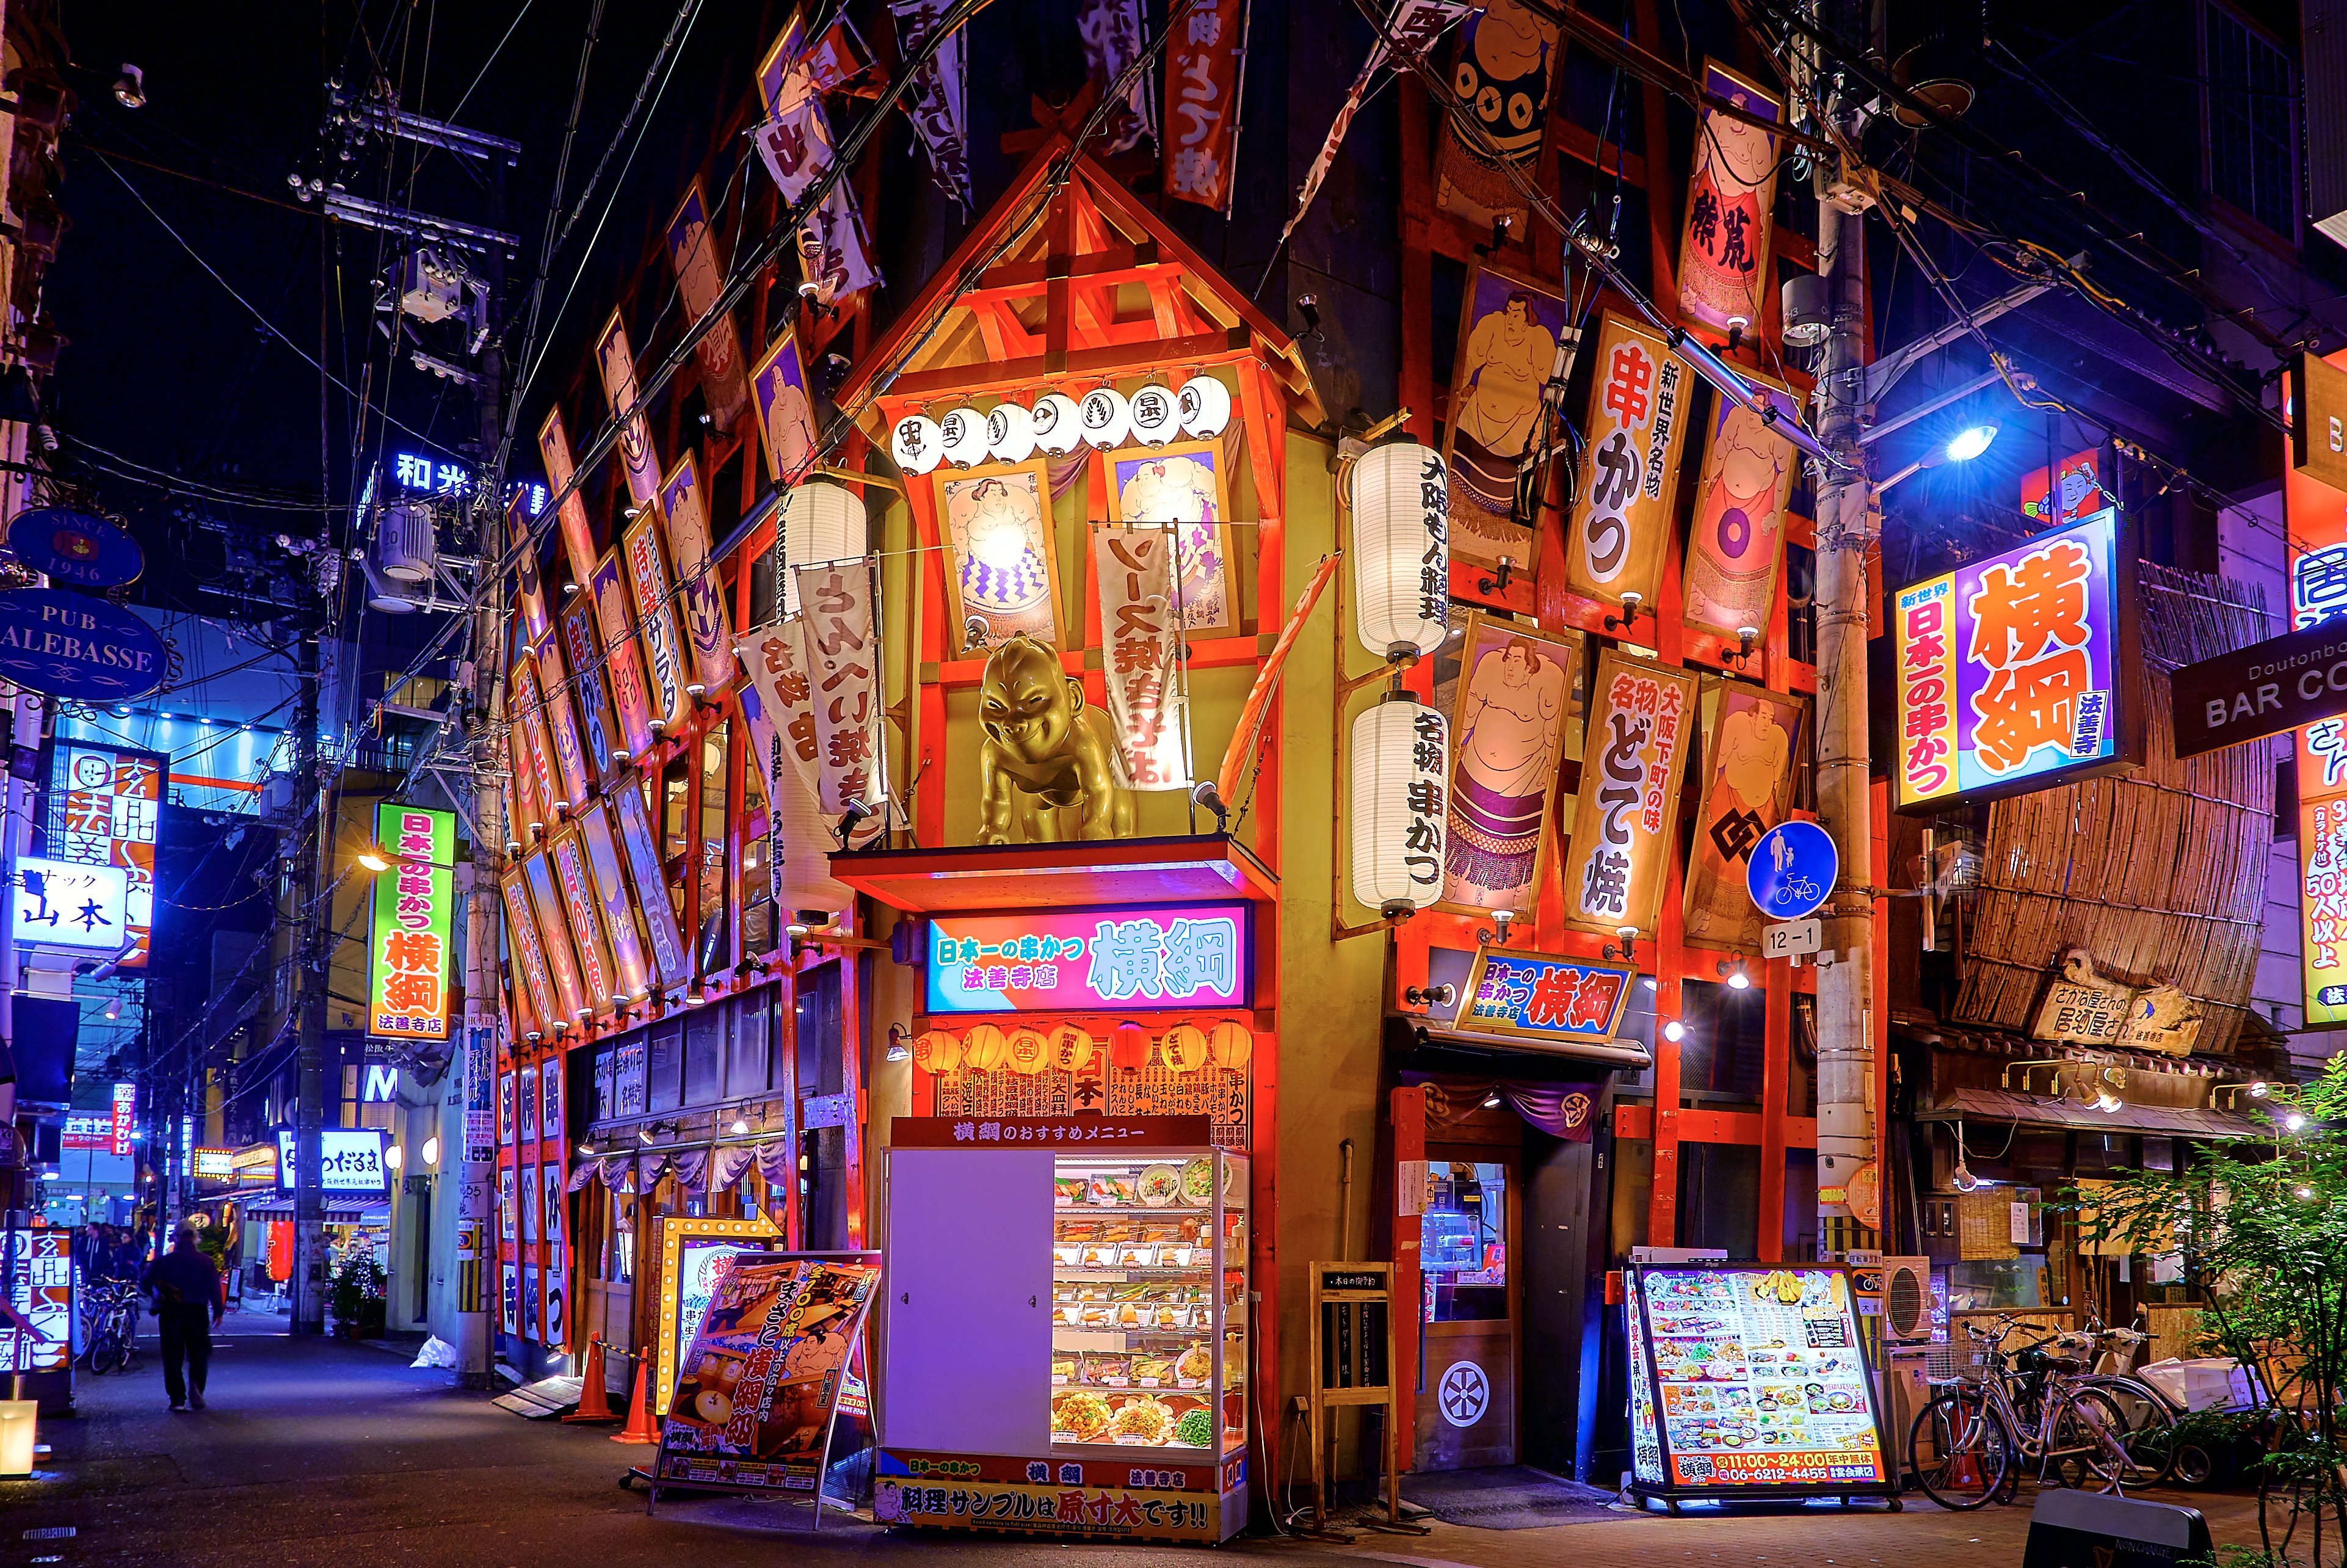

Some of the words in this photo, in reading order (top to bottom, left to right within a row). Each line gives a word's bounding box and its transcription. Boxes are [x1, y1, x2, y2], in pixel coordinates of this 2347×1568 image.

[1644, 361, 1680, 498] 新世界名物
[2329, 416, 2347, 452] B
[1588, 345, 1652, 575] 串かつ
[50, 513, 109, 538] SINCE
[385, 531, 398, 545] 20
[1418, 456, 1448, 632] 大阪もん料理
[46, 556, 101, 581] 1946
[1901, 584, 1950, 609] 新世界
[42, 604, 97, 631] PUB
[1, 626, 153, 673] ALEBASSE
[1971, 543, 2088, 772] 横綱
[1611, 675, 1658, 714] 名物
[1905, 601, 1948, 794] 日本一の串かつ
[2207, 681, 2283, 729] BAR
[2073, 695, 2103, 755] 法善寺
[1642, 685, 1682, 831] 大阪下町の味
[1404, 711, 1443, 885] 名物串かつ
[1586, 713, 1652, 915] どて焼
[23, 895, 113, 934] 山本
[2305, 874, 2337, 968] 50人以上
[938, 935, 1085, 966] 日本一の串かつ
[1087, 918, 1237, 999] 横綱
[382, 930, 442, 1015] 横綱
[963, 965, 1059, 990] 法善寺店
[1483, 963, 1536, 984] 日本一の
[1476, 982, 1529, 1004] 串かつ
[1526, 967, 1622, 1031] 横綱
[2055, 985, 2126, 1012] さかな屋さんの
[2326, 987, 2347, 1004] 法
[377, 1015, 444, 1033] 法善寺店
[1471, 1003, 1521, 1019] 法善寺店
[2054, 1007, 2130, 1039] 居酒屋さん
[1051, 1084, 1068, 1117] 大皿料
[1184, 1084, 1192, 1115] 鶏も
[1200, 1084, 1210, 1115] 豚バ
[1228, 1071, 1245, 1123] 串かつ
[953, 1120, 1145, 1144] 横綱のおすすめメニュー
[1862, 1304, 1882, 1313] 大阪
[909, 1459, 980, 1475] 日本一の串かつ
[1026, 1461, 1083, 1484] 横綱
[1730, 1467, 1827, 1481] 06-6212-4455
[1827, 1454, 1873, 1465] 年中無休
[1130, 1468, 1186, 1488] 法善寺店
